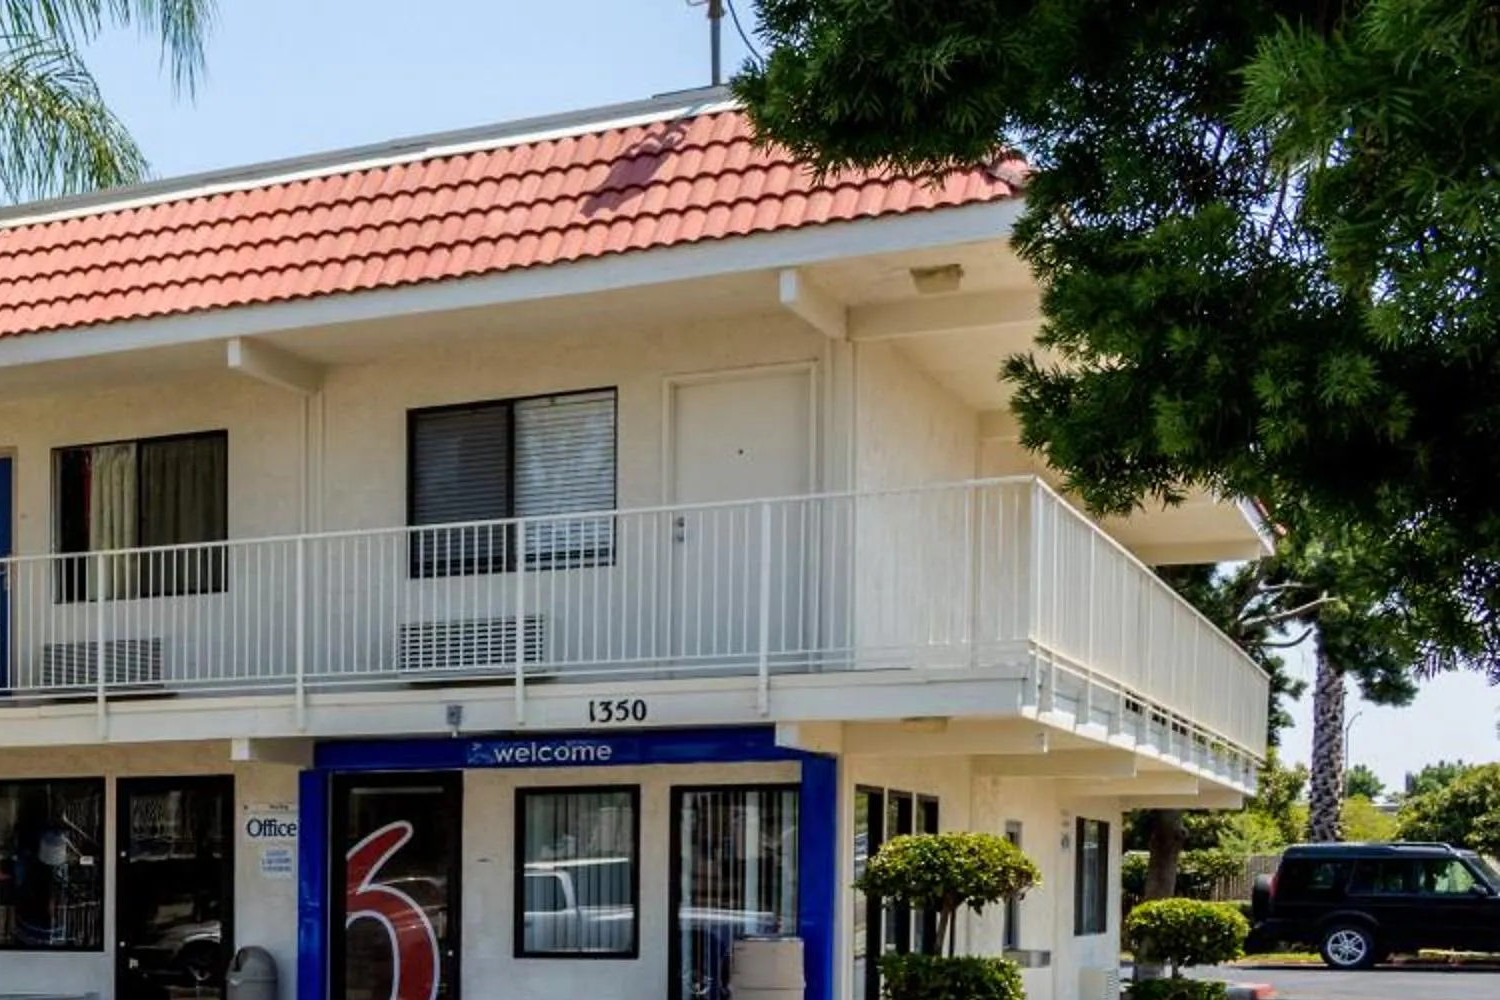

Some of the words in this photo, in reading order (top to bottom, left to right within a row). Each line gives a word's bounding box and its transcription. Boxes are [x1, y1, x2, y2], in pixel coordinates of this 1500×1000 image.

[589, 699, 648, 723] 1350
[494, 742, 612, 763] welcome
[247, 818, 297, 837] Office
